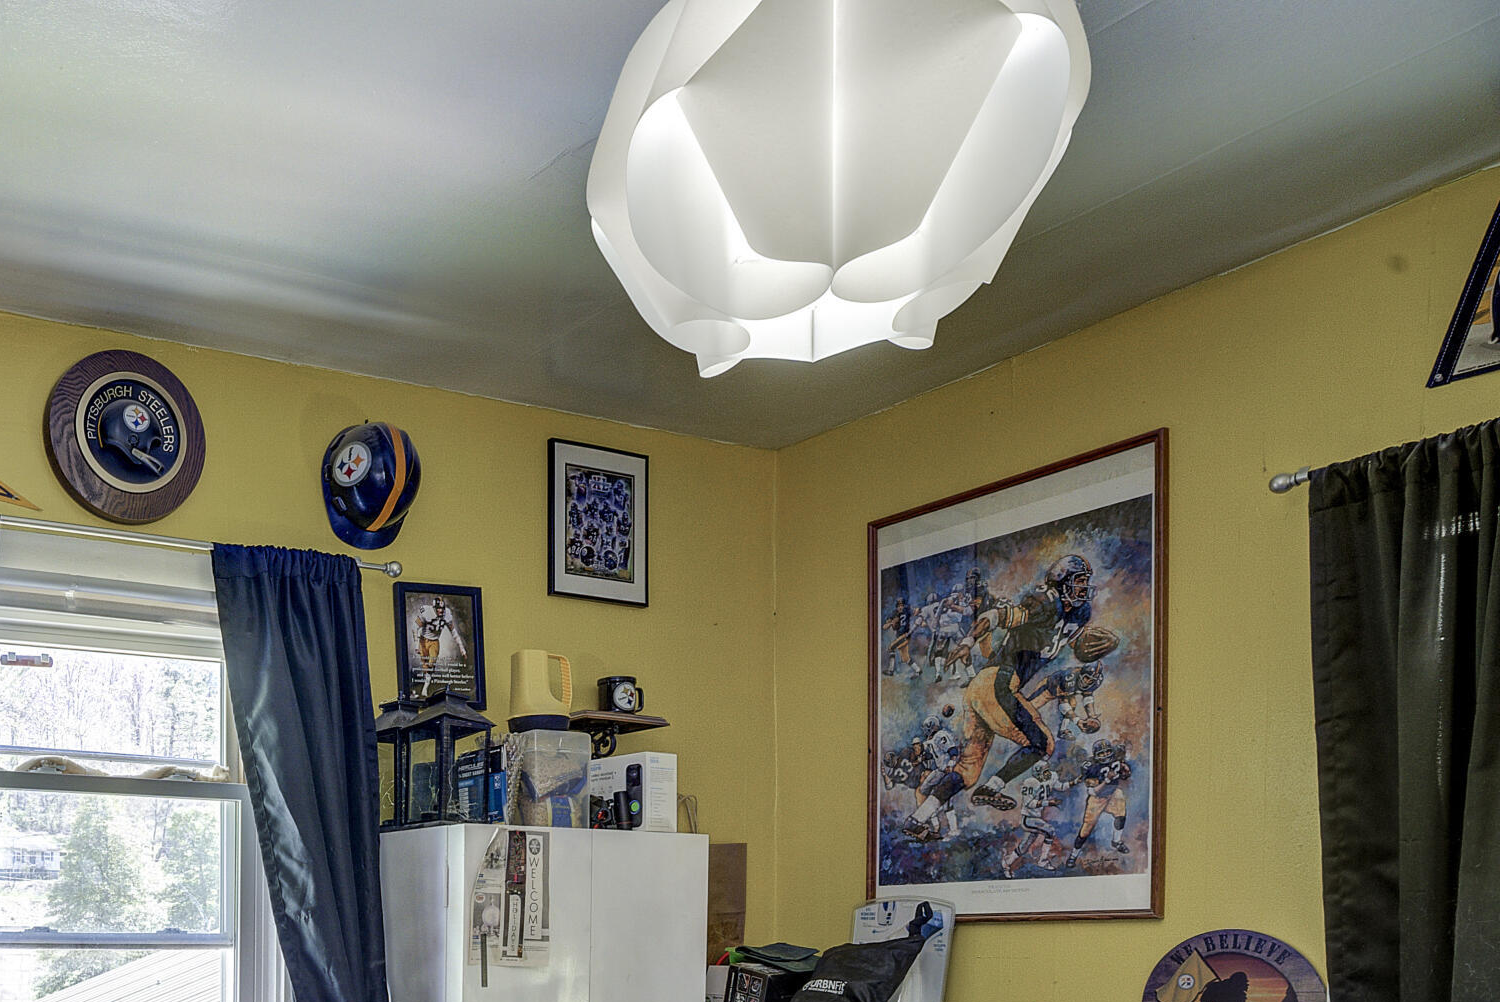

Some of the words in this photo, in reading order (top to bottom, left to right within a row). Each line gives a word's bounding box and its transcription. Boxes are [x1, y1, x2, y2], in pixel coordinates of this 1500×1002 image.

[87, 385, 134, 441] PITTSBURGH
[137, 389, 176, 454] STEELERS
[528, 856, 541, 937] WELCOME
[1203, 933, 1293, 966] BELIEVE
